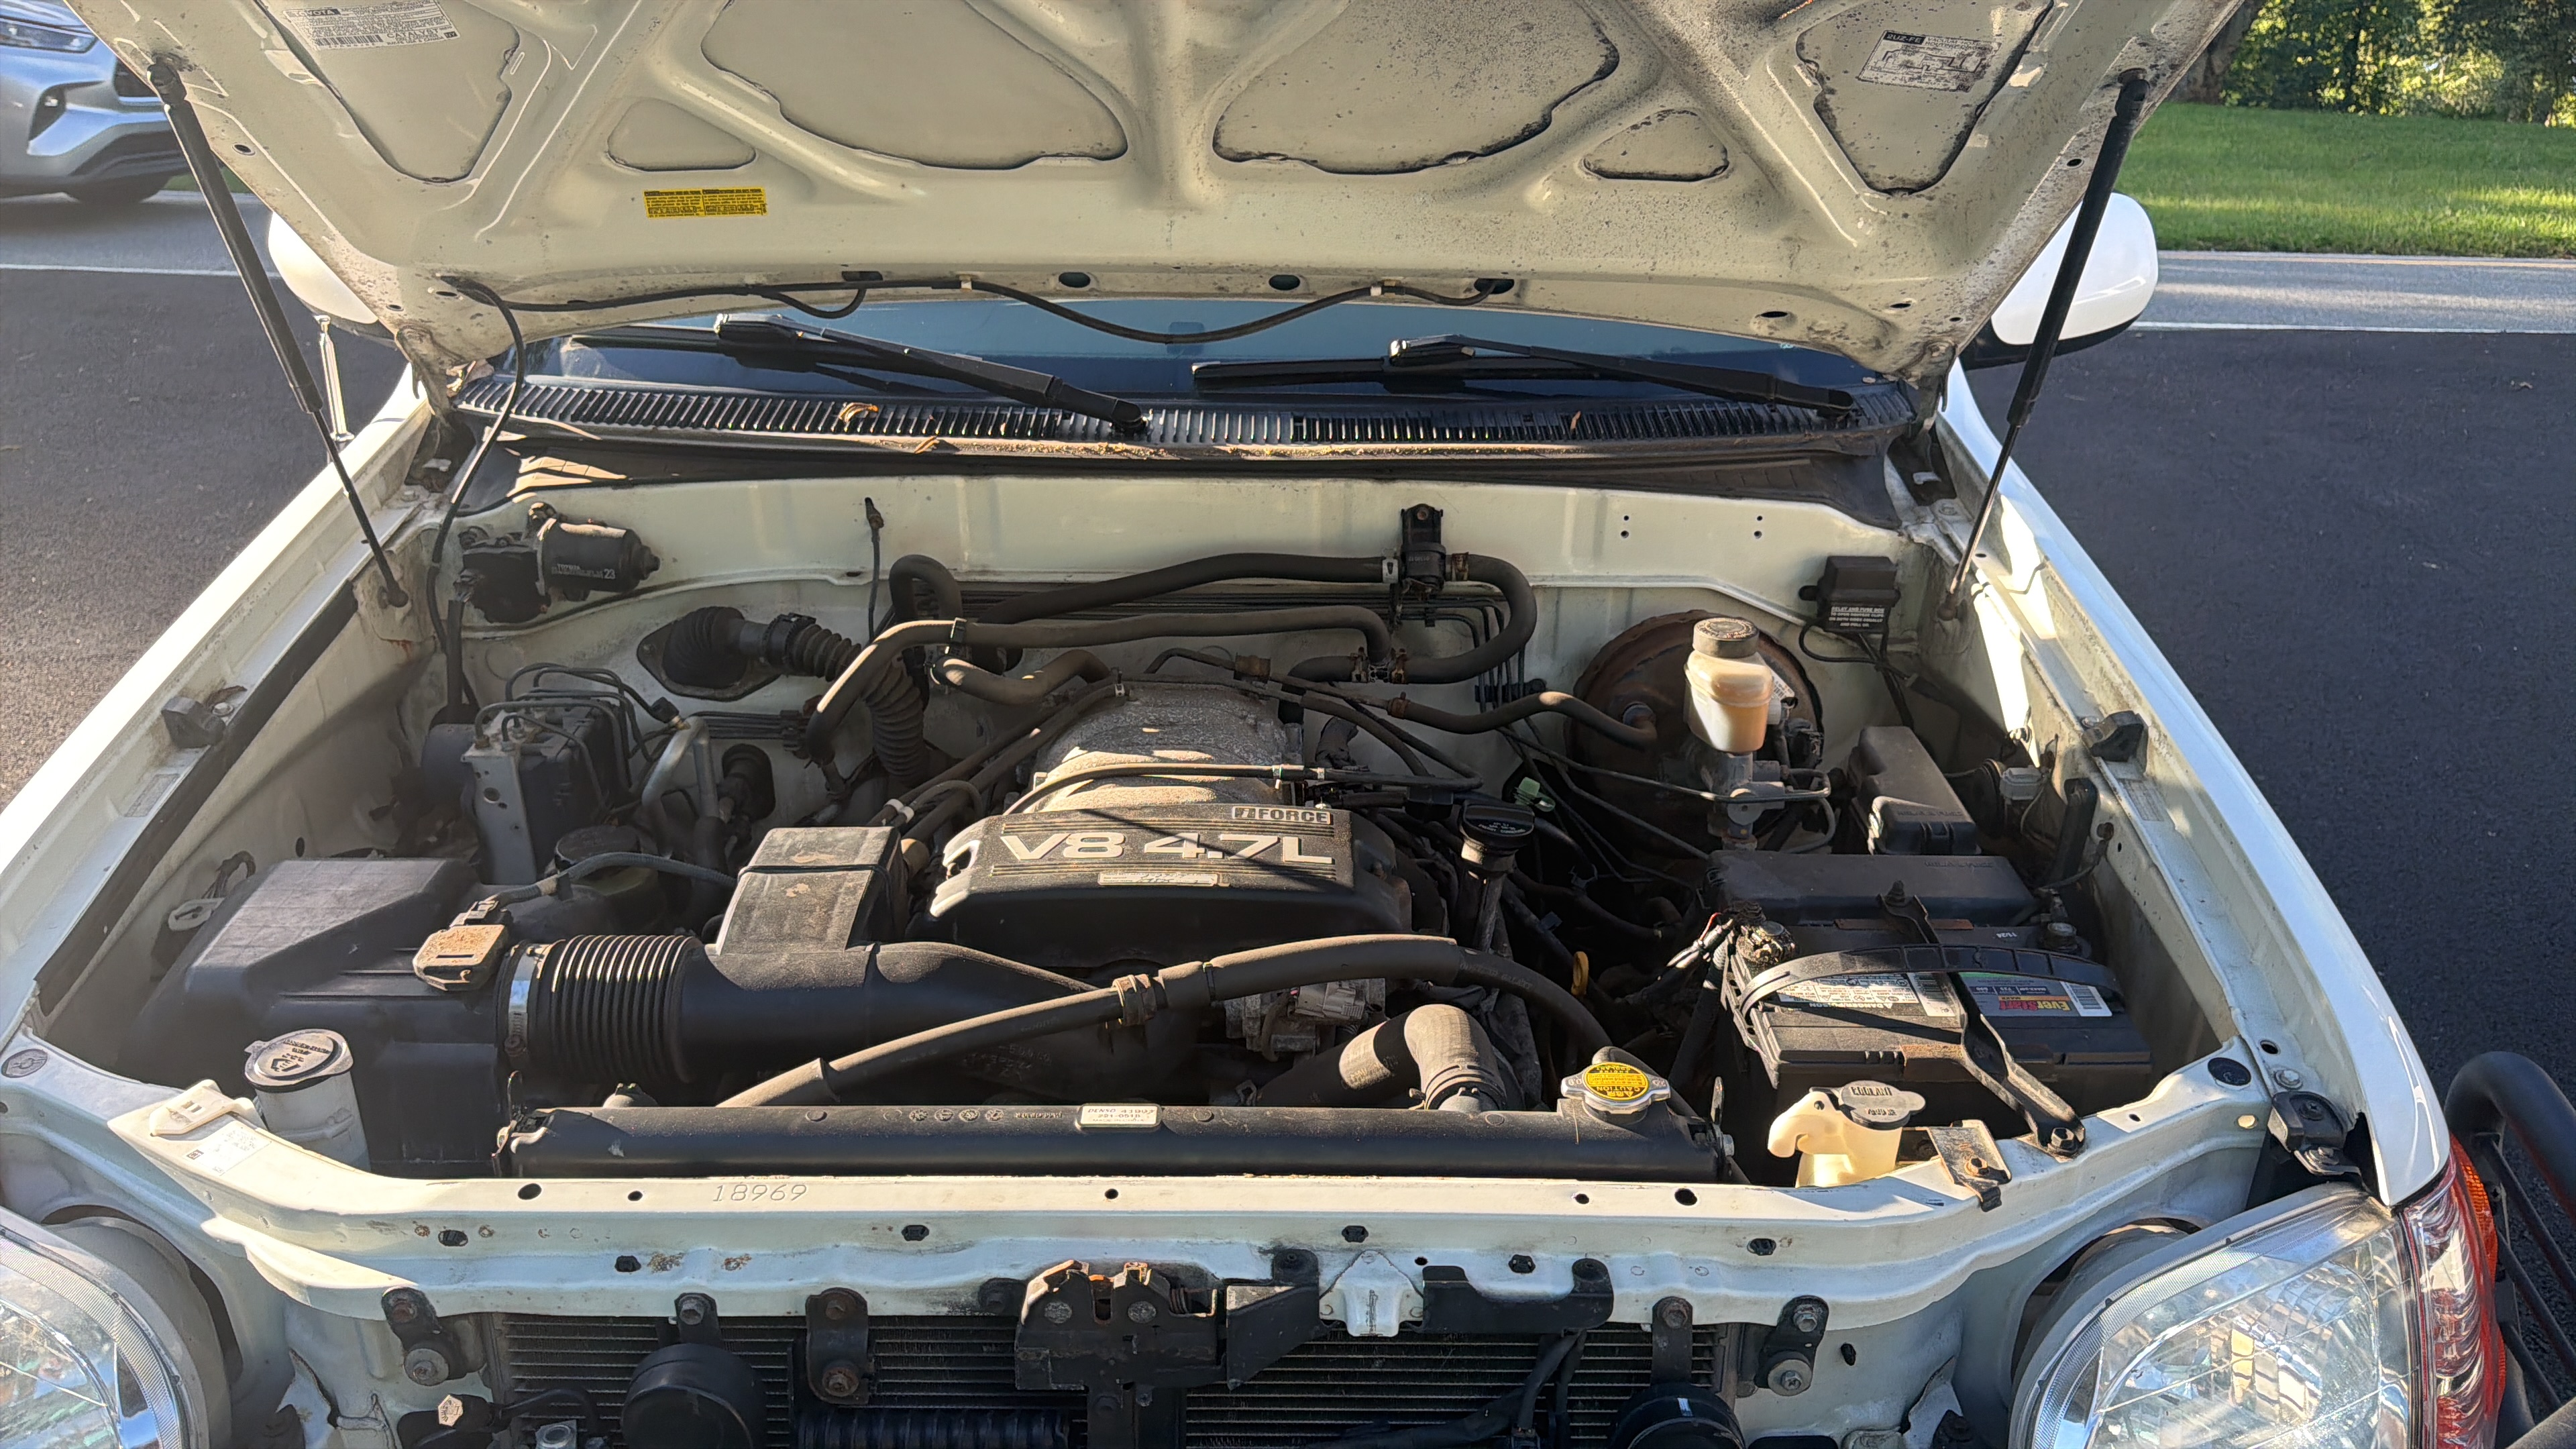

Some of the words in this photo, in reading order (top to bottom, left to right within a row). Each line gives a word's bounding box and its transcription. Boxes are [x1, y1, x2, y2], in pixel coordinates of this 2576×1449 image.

[386, 28, 439, 38] CATALYST
[604, 568, 616, 580] 23
[1258, 808, 1328, 823] FORCE
[1000, 832, 1126, 861] V8
[1144, 833, 1334, 865] 4.7L
[1999, 1001, 2070, 1011] EverStart
[712, 1183, 807, 1202] 18969
